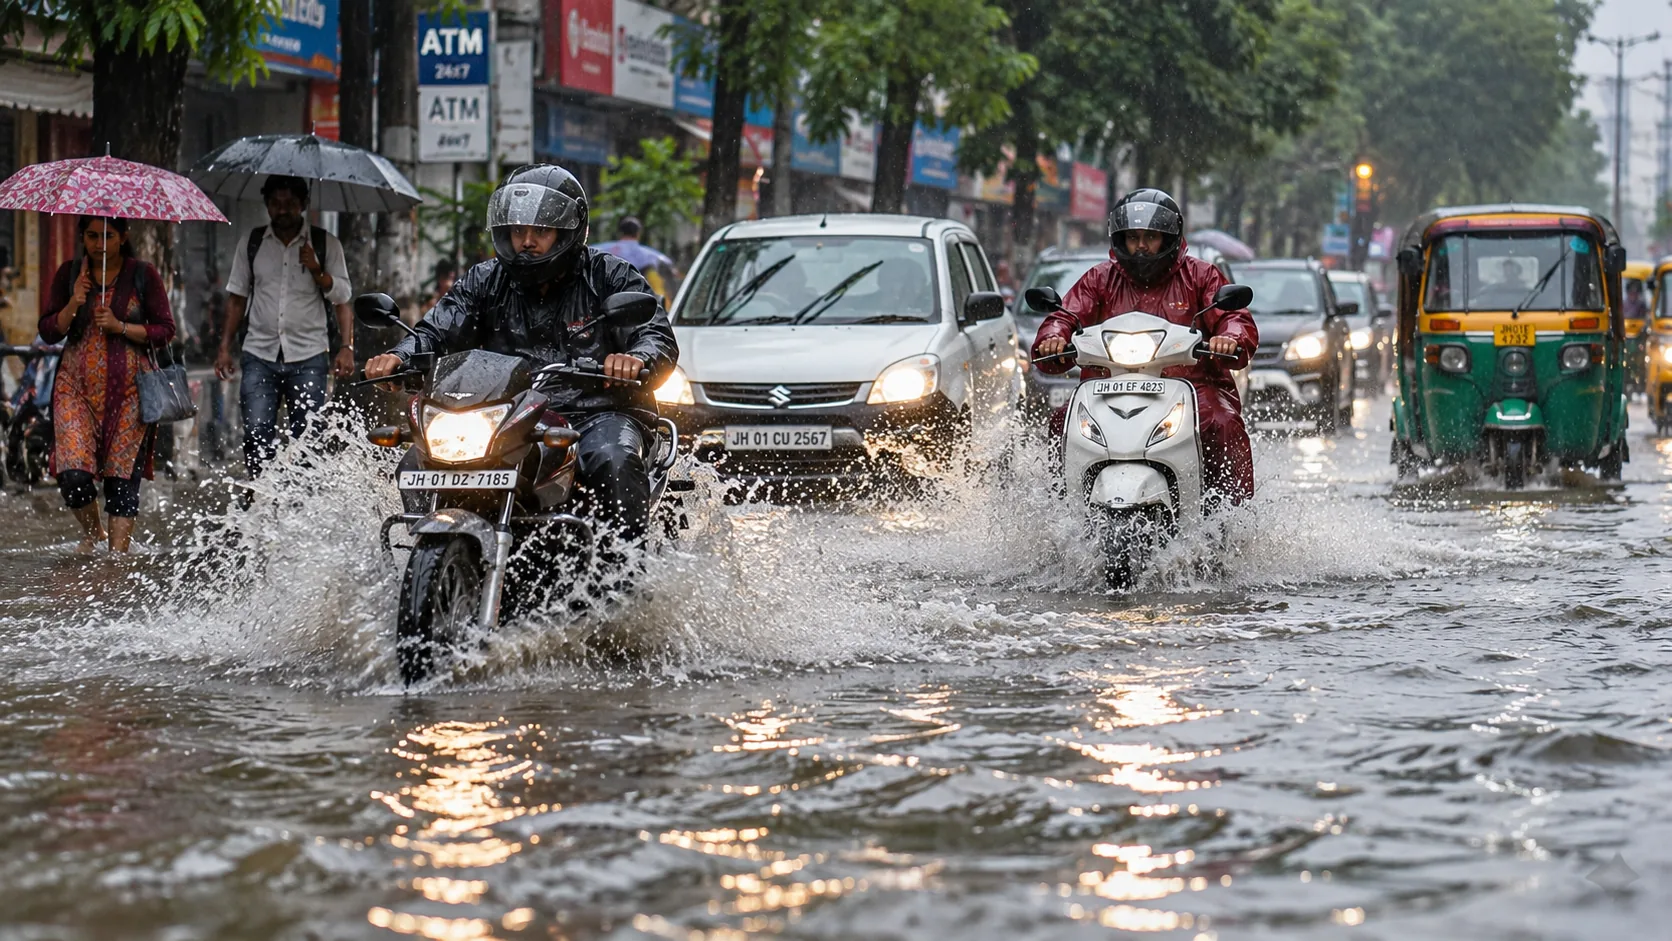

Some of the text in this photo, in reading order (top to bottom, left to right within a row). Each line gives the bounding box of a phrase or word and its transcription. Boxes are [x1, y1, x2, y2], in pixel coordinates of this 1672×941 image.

[421, 28, 483, 56] ATM
[429, 96, 480, 120] ATM
[1097, 383, 1110, 392] JH
[1112, 382, 1123, 392] 01
[1126, 382, 1138, 391] EF
[732, 431, 827, 445] JH 01 CU 2567
